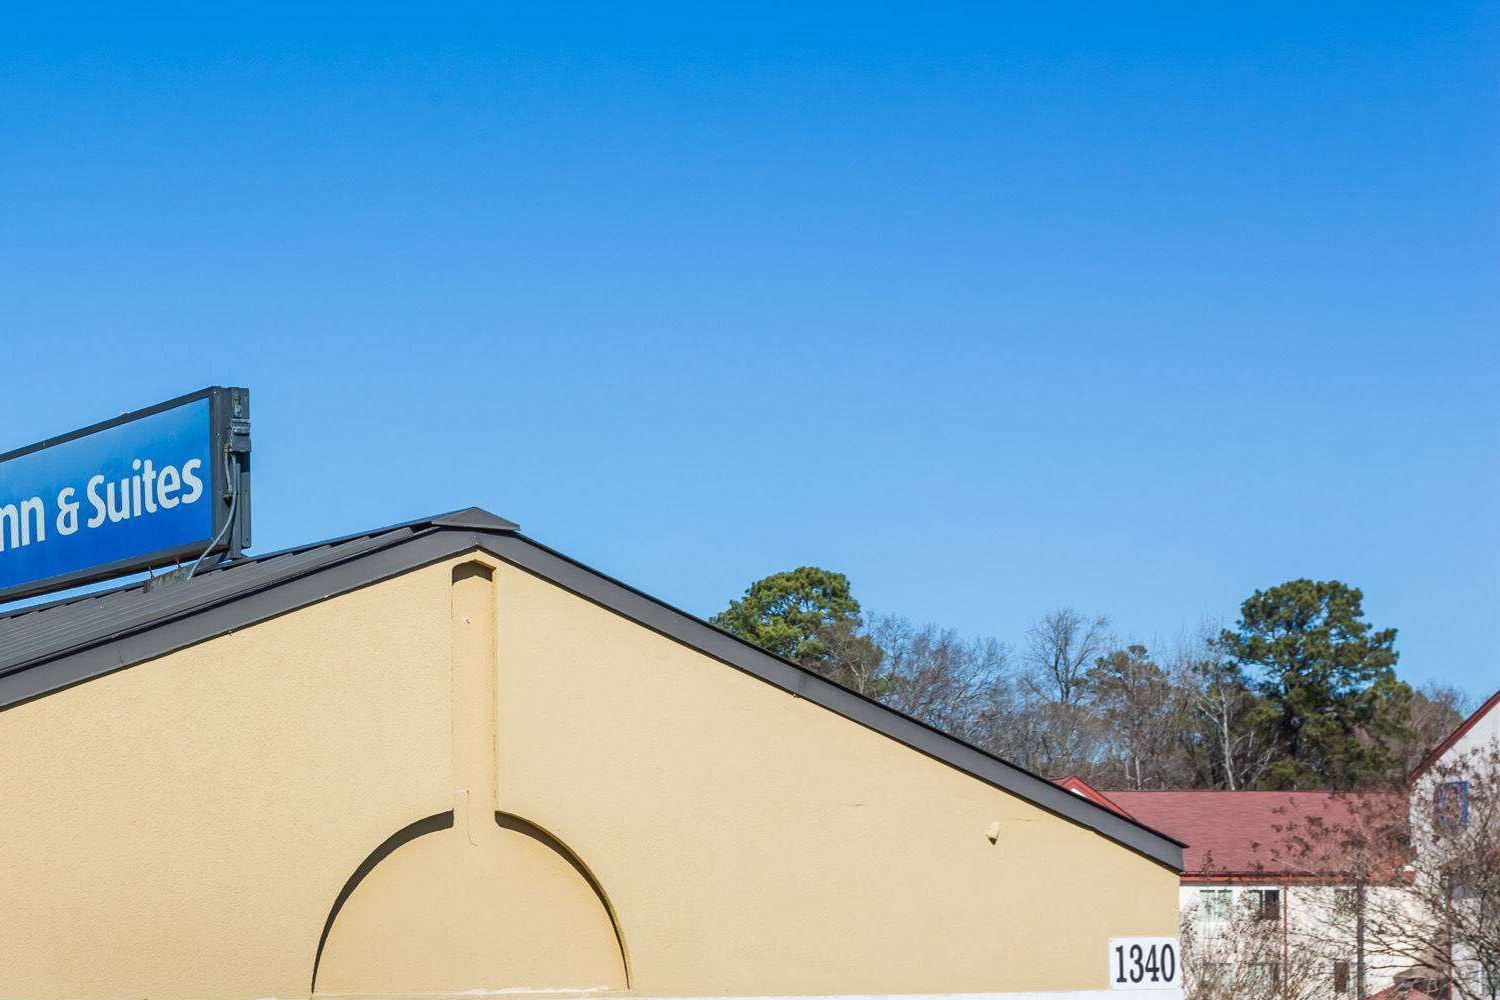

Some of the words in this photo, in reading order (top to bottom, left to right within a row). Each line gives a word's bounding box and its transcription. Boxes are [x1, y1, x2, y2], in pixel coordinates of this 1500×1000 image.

[56, 487, 79, 536] &
[87, 457, 204, 529] Suites
[1115, 943, 1175, 983] 1340
